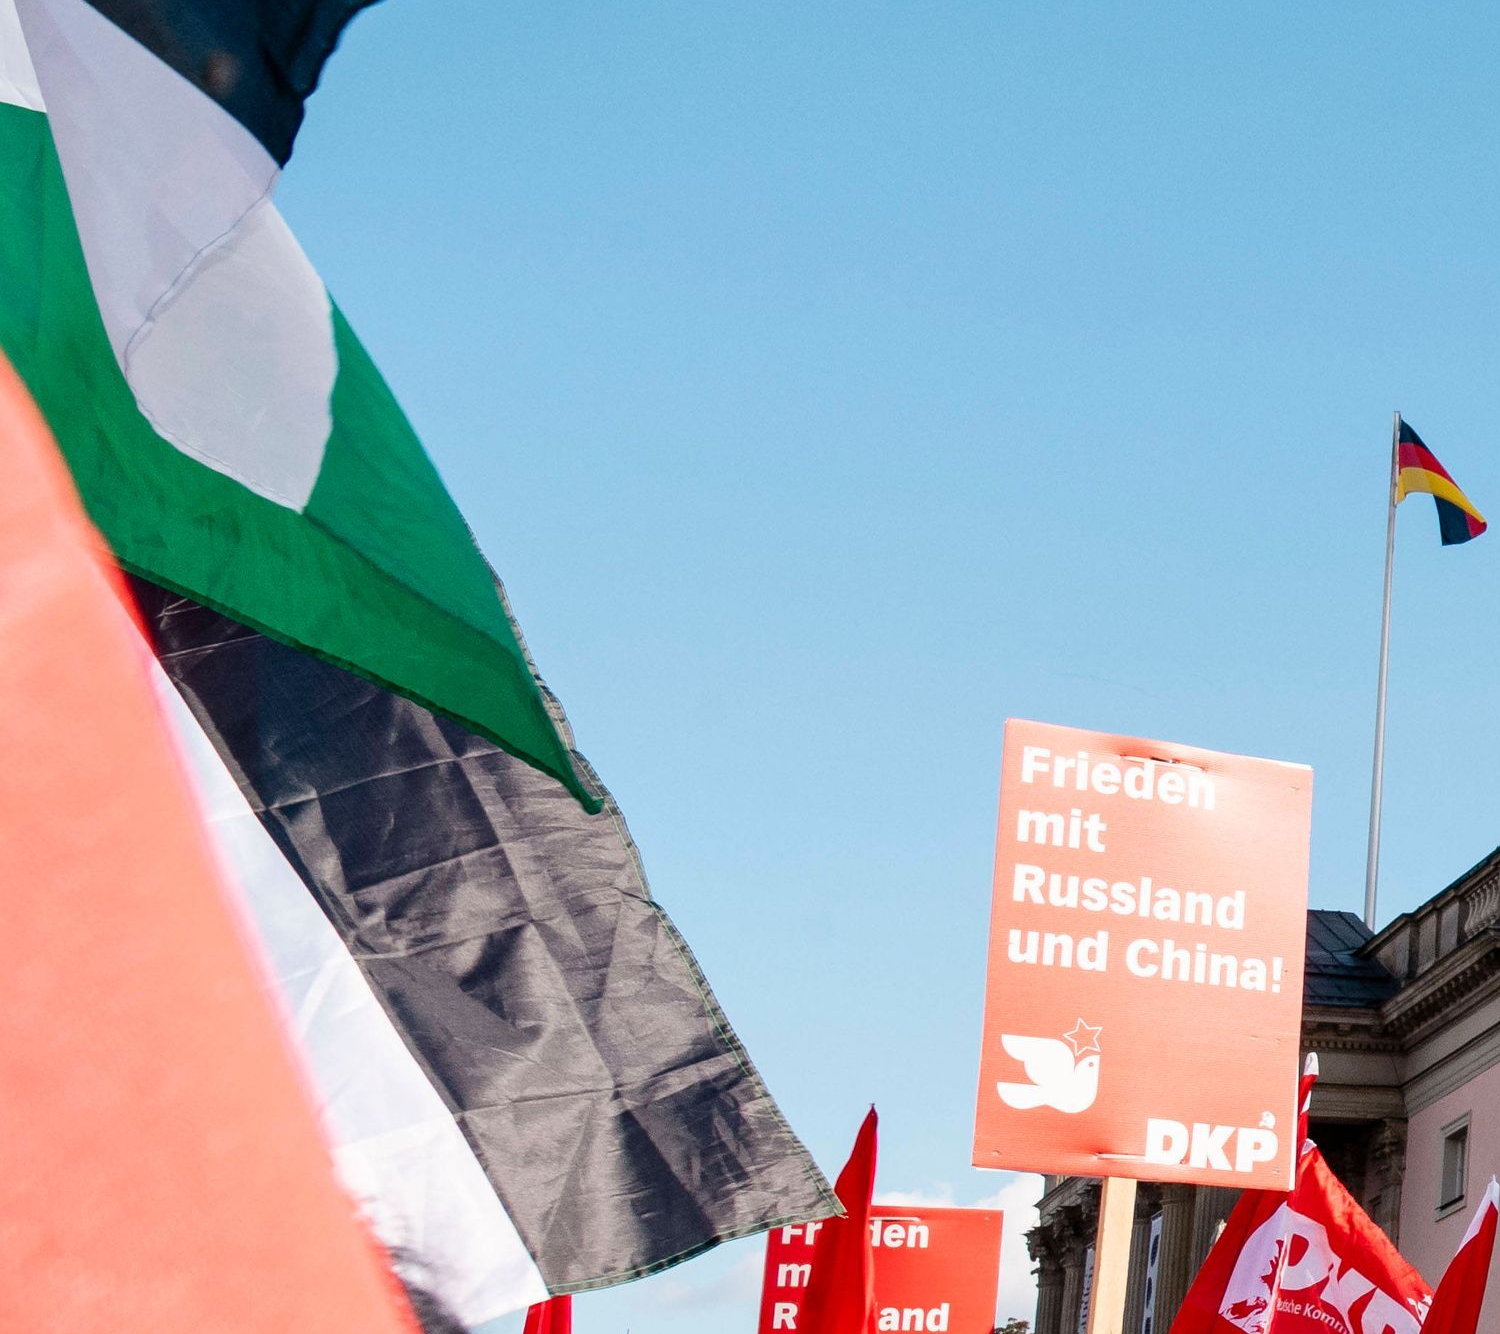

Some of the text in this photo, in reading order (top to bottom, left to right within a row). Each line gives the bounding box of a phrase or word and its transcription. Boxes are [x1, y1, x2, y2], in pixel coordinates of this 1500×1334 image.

[1020, 745, 1217, 811] Frieden
[1016, 807, 1108, 853] mit
[1011, 863, 1246, 931] Russland
[1007, 928, 1284, 994] und China!
[1144, 1119, 1280, 1173] DKP
[781, 1220, 930, 1248] Frden
